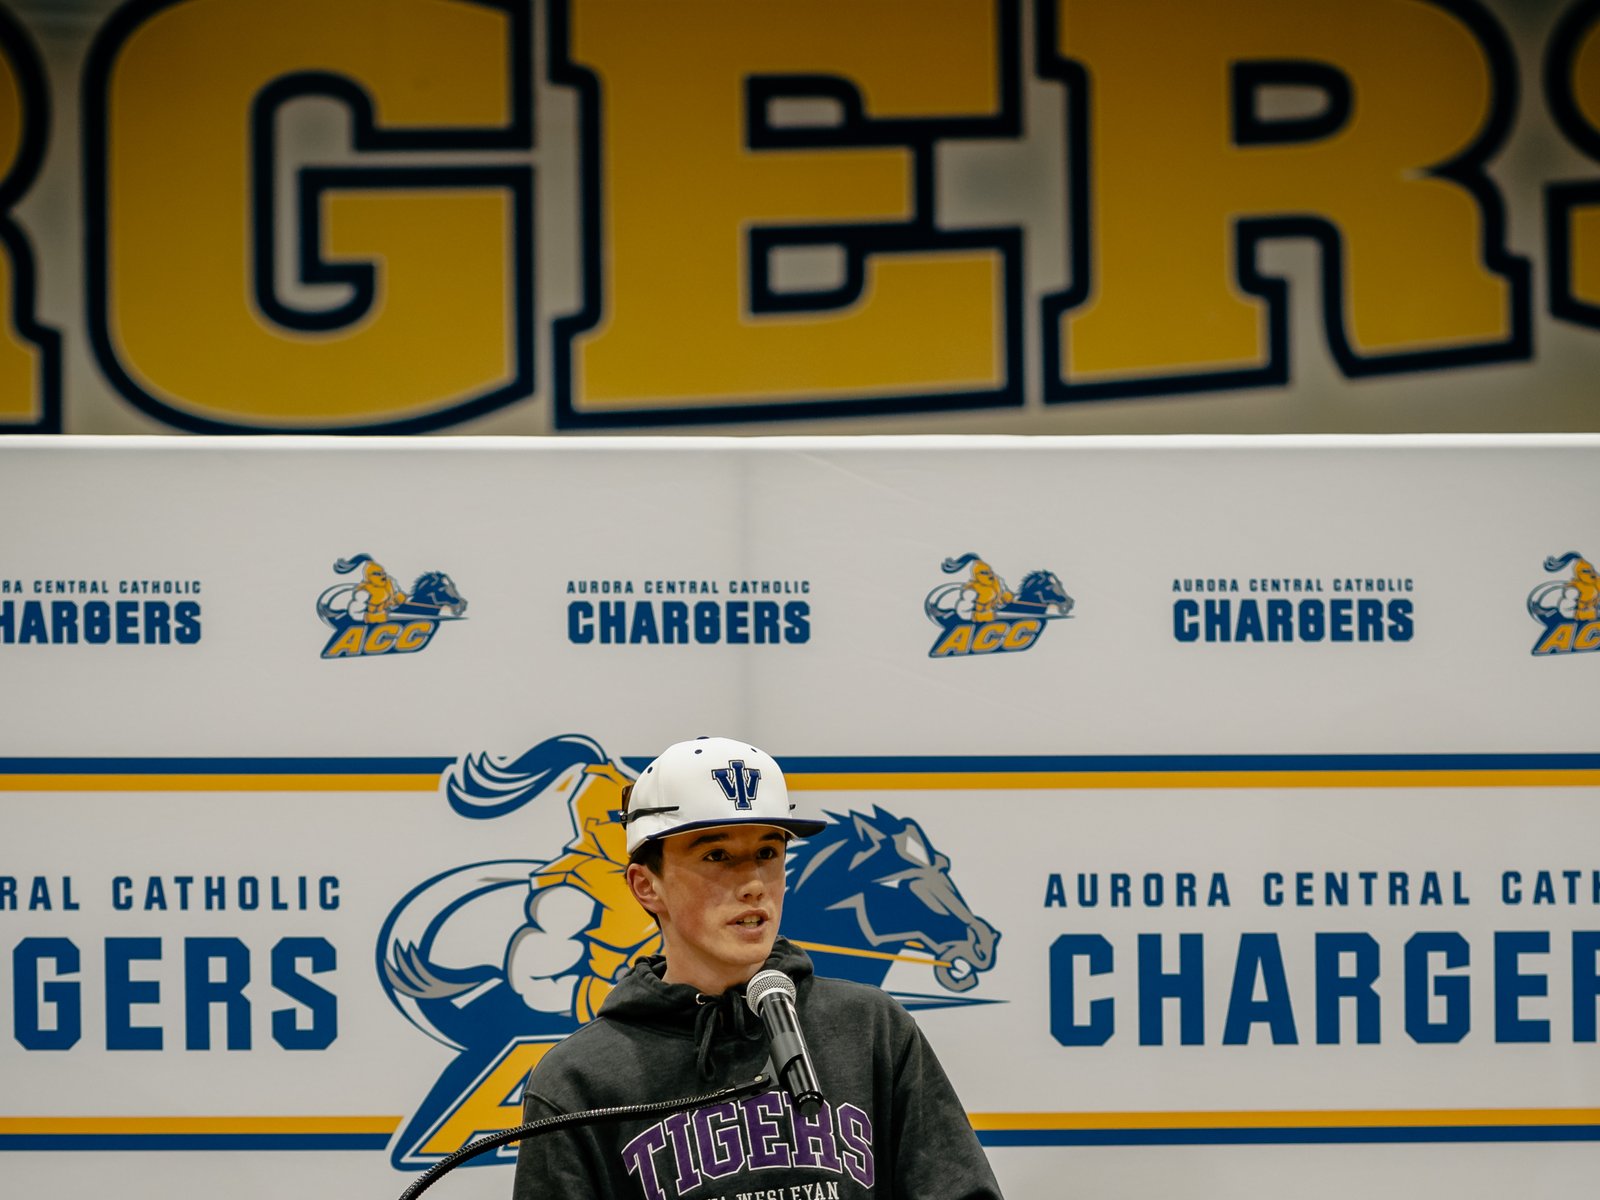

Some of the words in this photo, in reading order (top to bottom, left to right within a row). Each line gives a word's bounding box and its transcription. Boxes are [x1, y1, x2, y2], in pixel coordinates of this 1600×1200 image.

[0, 0, 1600, 435] GER
[33, 580, 108, 594] CENTRAL
[119, 580, 201, 594] CATHOLIC
[566, 580, 634, 594] AURORA
[644, 580, 719, 594] CENTRAL
[729, 580, 810, 594] CATHOLIC
[1172, 578, 1239, 593] AURORA
[1249, 578, 1323, 593] CENTRAL
[1333, 578, 1413, 592] CATHOLIC
[329, 621, 432, 656] ACC
[567, 600, 811, 645] CHARGERS
[937, 620, 1039, 655] ACC
[1173, 598, 1414, 643] CHARGERS
[0, 875, 80, 911] RAL
[112, 875, 340, 911] CATHOLIC
[1044, 872, 1231, 908] AURORA
[1263, 871, 1470, 907] CENTRAL
[12, 936, 338, 1051] GERS
